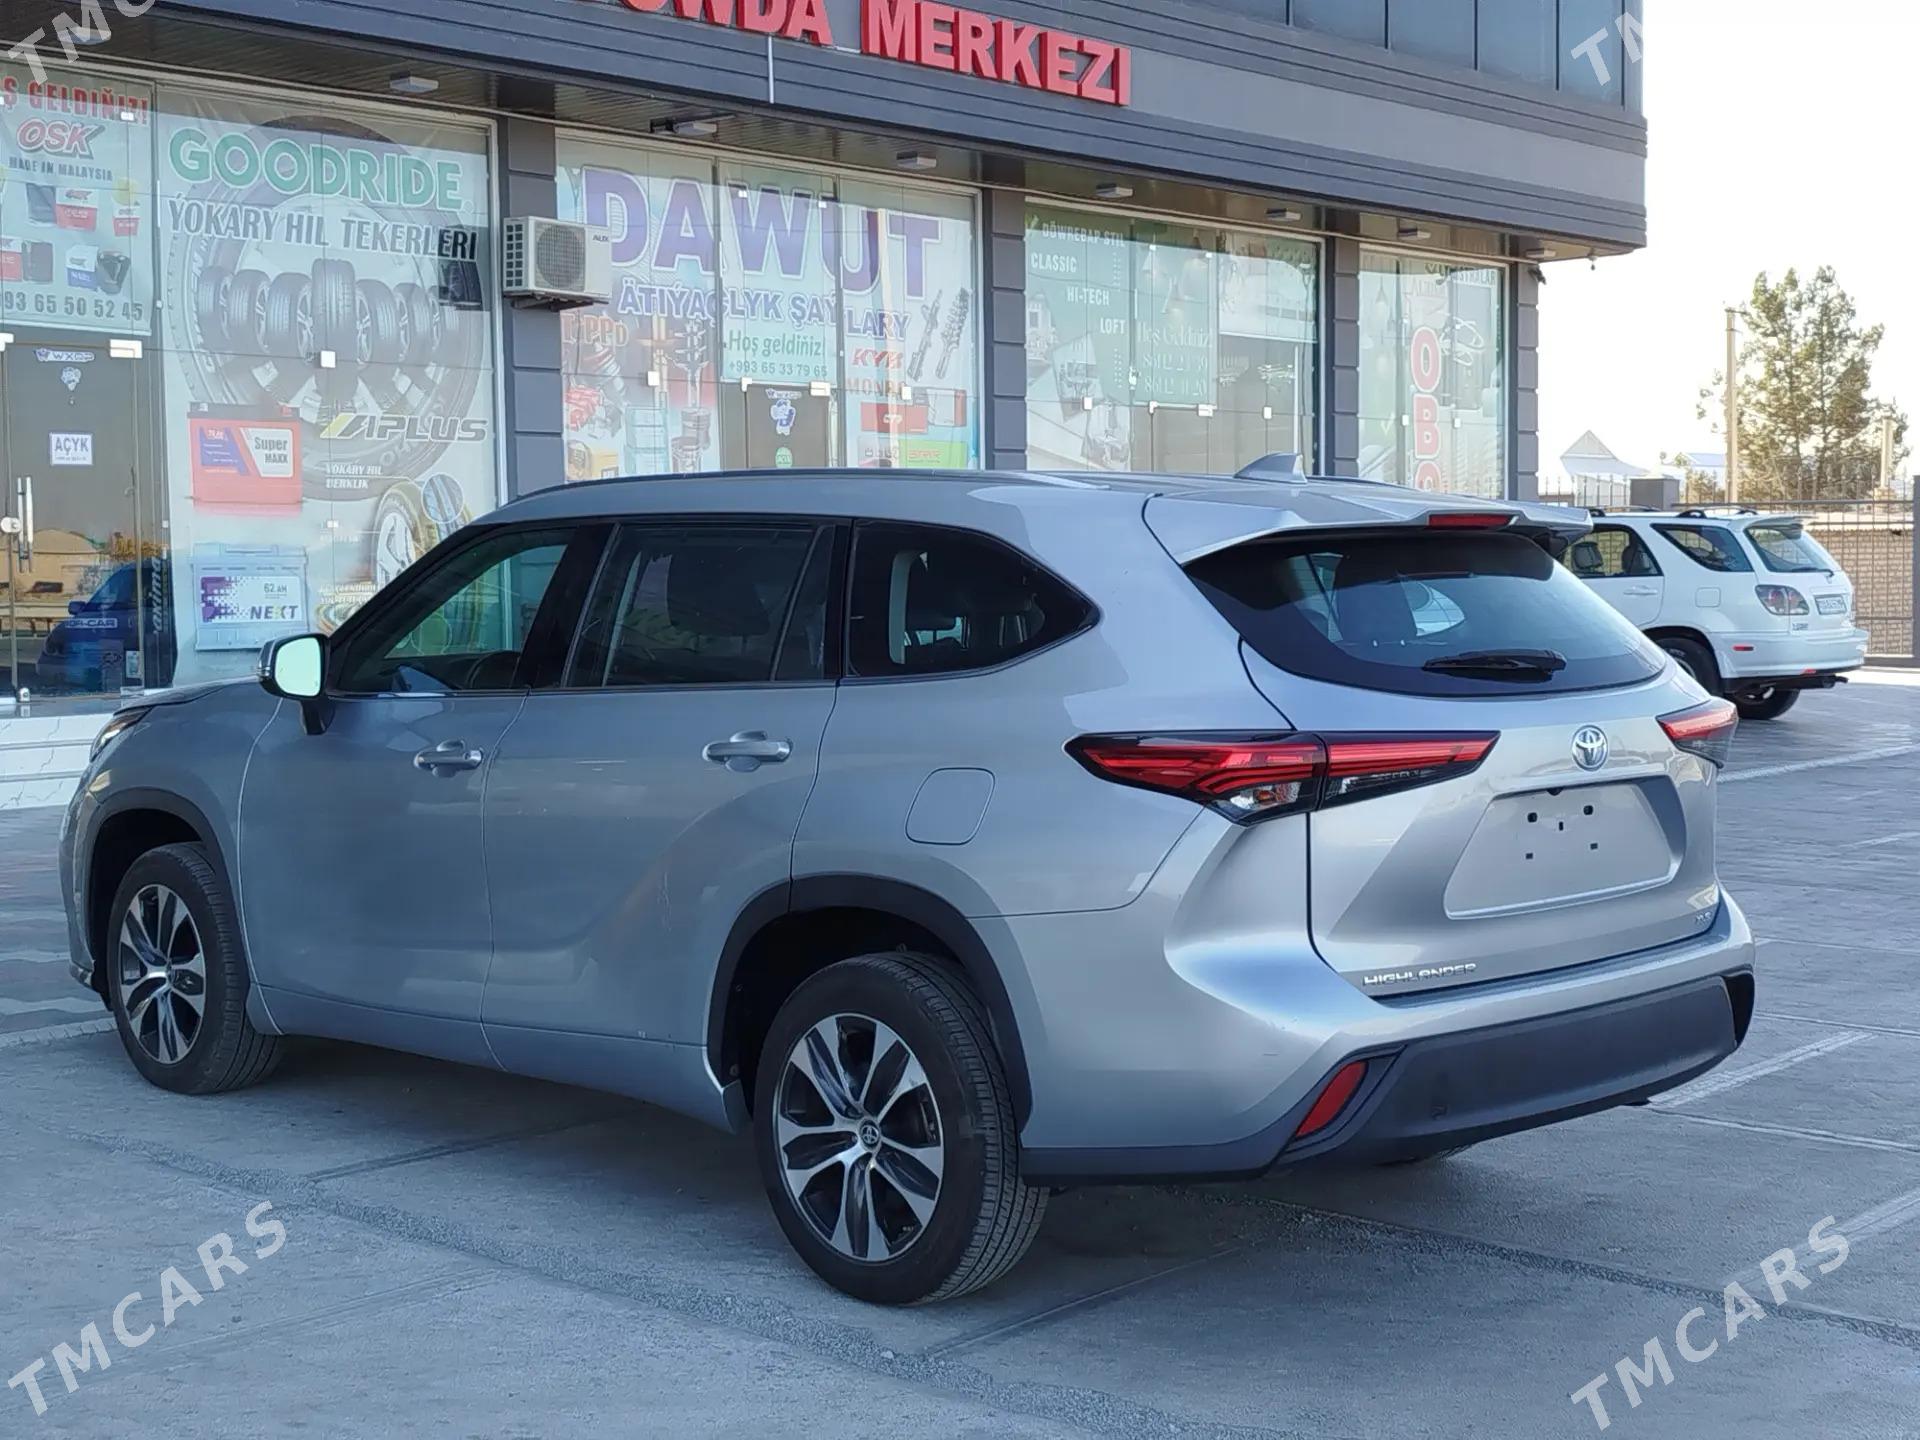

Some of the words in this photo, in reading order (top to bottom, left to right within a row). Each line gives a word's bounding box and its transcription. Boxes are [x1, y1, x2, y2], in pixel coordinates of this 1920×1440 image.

[861, 0, 1131, 106] MERKEZI
[17, 117, 104, 159] OSK
[41, 161, 54, 174] IN
[58, 163, 113, 181] MALAYSIA
[169, 127, 465, 212] GOODRIDE
[168, 193, 281, 242] ÝOKARY
[285, 213, 330, 248] HIL
[340, 218, 478, 262] TEKERLERI
[581, 165, 943, 300] DAWUT
[1030, 252, 1078, 273] CLASSIC
[34, 293, 57, 313] 65
[64, 296, 87, 316] 50
[94, 299, 115, 318] 52
[121, 301, 143, 321] 45
[1067, 286, 1110, 306] HI-TECH
[1100, 318, 1126, 334] LOFT
[729, 330, 759, 357] Hoş
[729, 360, 758, 373] +993
[761, 361, 776, 374] 65
[780, 363, 793, 376] 33
[326, 413, 488, 442] APLUS
[54, 436, 89, 456] AÇYK
[254, 436, 288, 451] Super
[264, 582, 274, 593] 62
[249, 604, 299, 620] NEXT
[1362, 962, 1477, 986] HIGHLANDER
